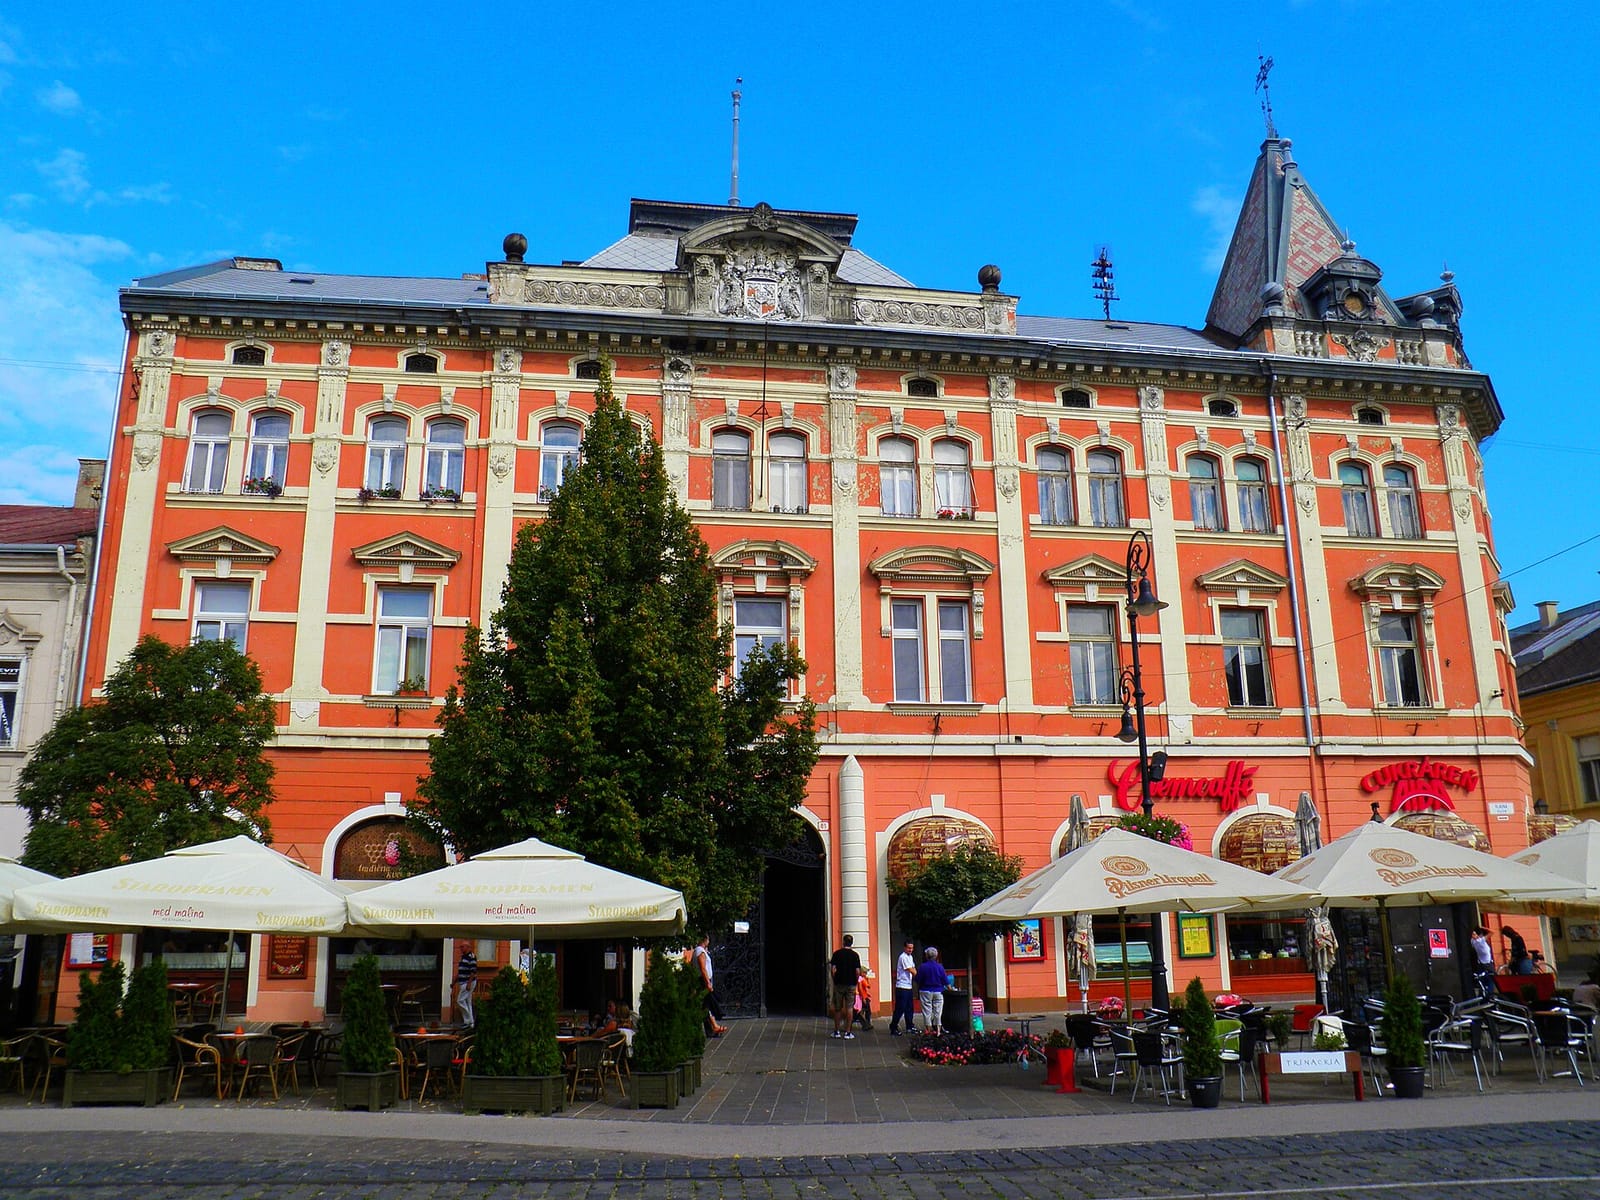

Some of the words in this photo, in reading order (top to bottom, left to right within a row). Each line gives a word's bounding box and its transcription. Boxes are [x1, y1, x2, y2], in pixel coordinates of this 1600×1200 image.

[1360, 756, 1479, 793] CUKRÁREŇ
[1390, 778, 1456, 812] AIDA
[1376, 868, 1430, 887] Pilsner
[1424, 865, 1484, 878] Urquell
[112, 878, 274, 897] STAROPRAMEN
[436, 881, 594, 895] STAROPRAMEN
[1104, 877, 1160, 899] Pilsner
[1154, 873, 1218, 887] Urquell
[34, 901, 111, 918] STAROPRAMEN
[152, 905, 171, 916] med
[174, 906, 204, 918] malina
[363, 905, 435, 920] STAROPRAMEN
[485, 903, 503, 915] med
[506, 903, 537, 915] malina
[588, 904, 660, 918] STAROPRAMEN
[256, 911, 327, 927] STAROPRAMEN
